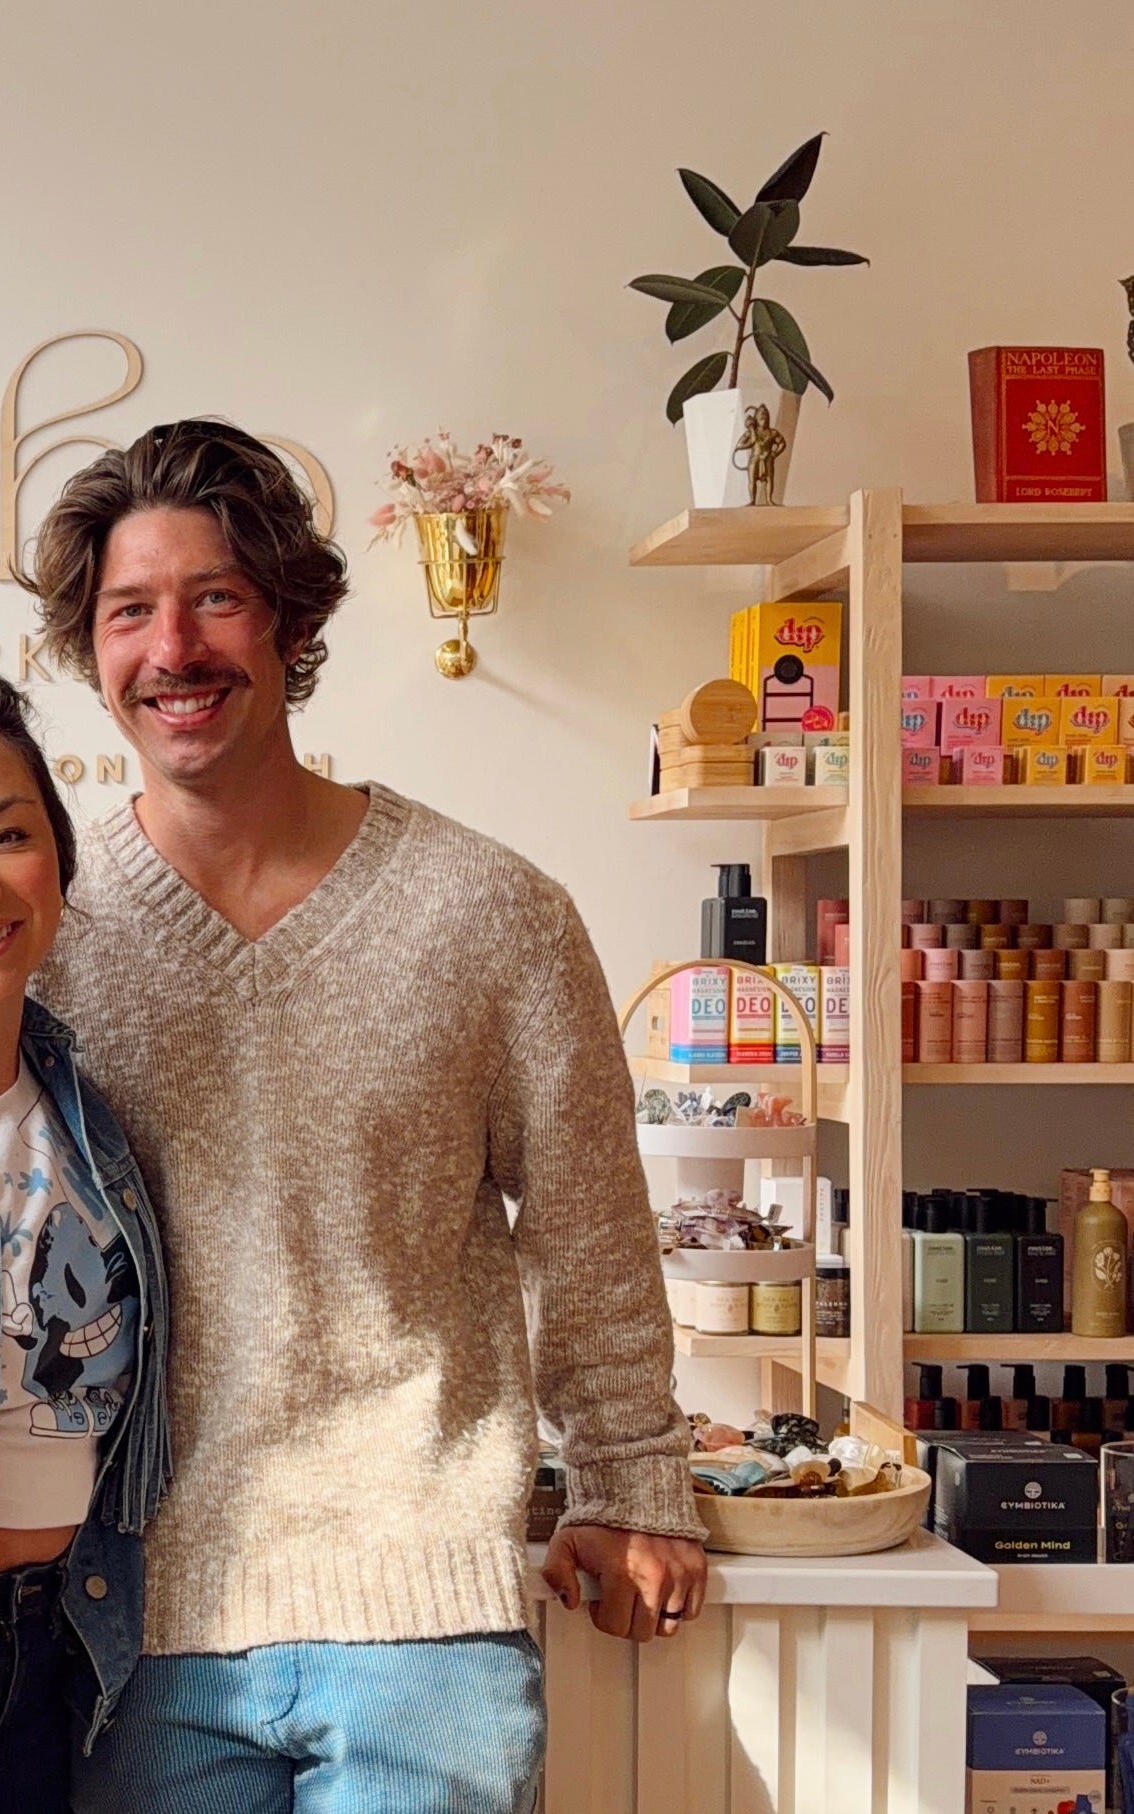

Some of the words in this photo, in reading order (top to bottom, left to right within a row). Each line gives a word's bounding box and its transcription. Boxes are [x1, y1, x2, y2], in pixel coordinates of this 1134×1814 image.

[1006, 352, 1097, 366] NAPOLEON
[1007, 366, 1026, 375] THE
[1033, 366, 1059, 375] LAST
[1066, 366, 1096, 375] PHASE
[1016, 488, 1041, 497] LORD
[777, 618, 823, 652] dip
[955, 707, 990, 733] dip
[1016, 708, 1051, 735] dip
[1072, 705, 1110, 733] dip
[692, 977, 726, 986] BRIXY
[826, 977, 849, 985] BRI
[691, 998, 726, 1015] DEO
[736, 997, 771, 1013] DEO
[826, 997, 848, 1013] DE
[994, 1541, 1038, 1550] Golden
[1040, 1541, 1071, 1550] Mind
